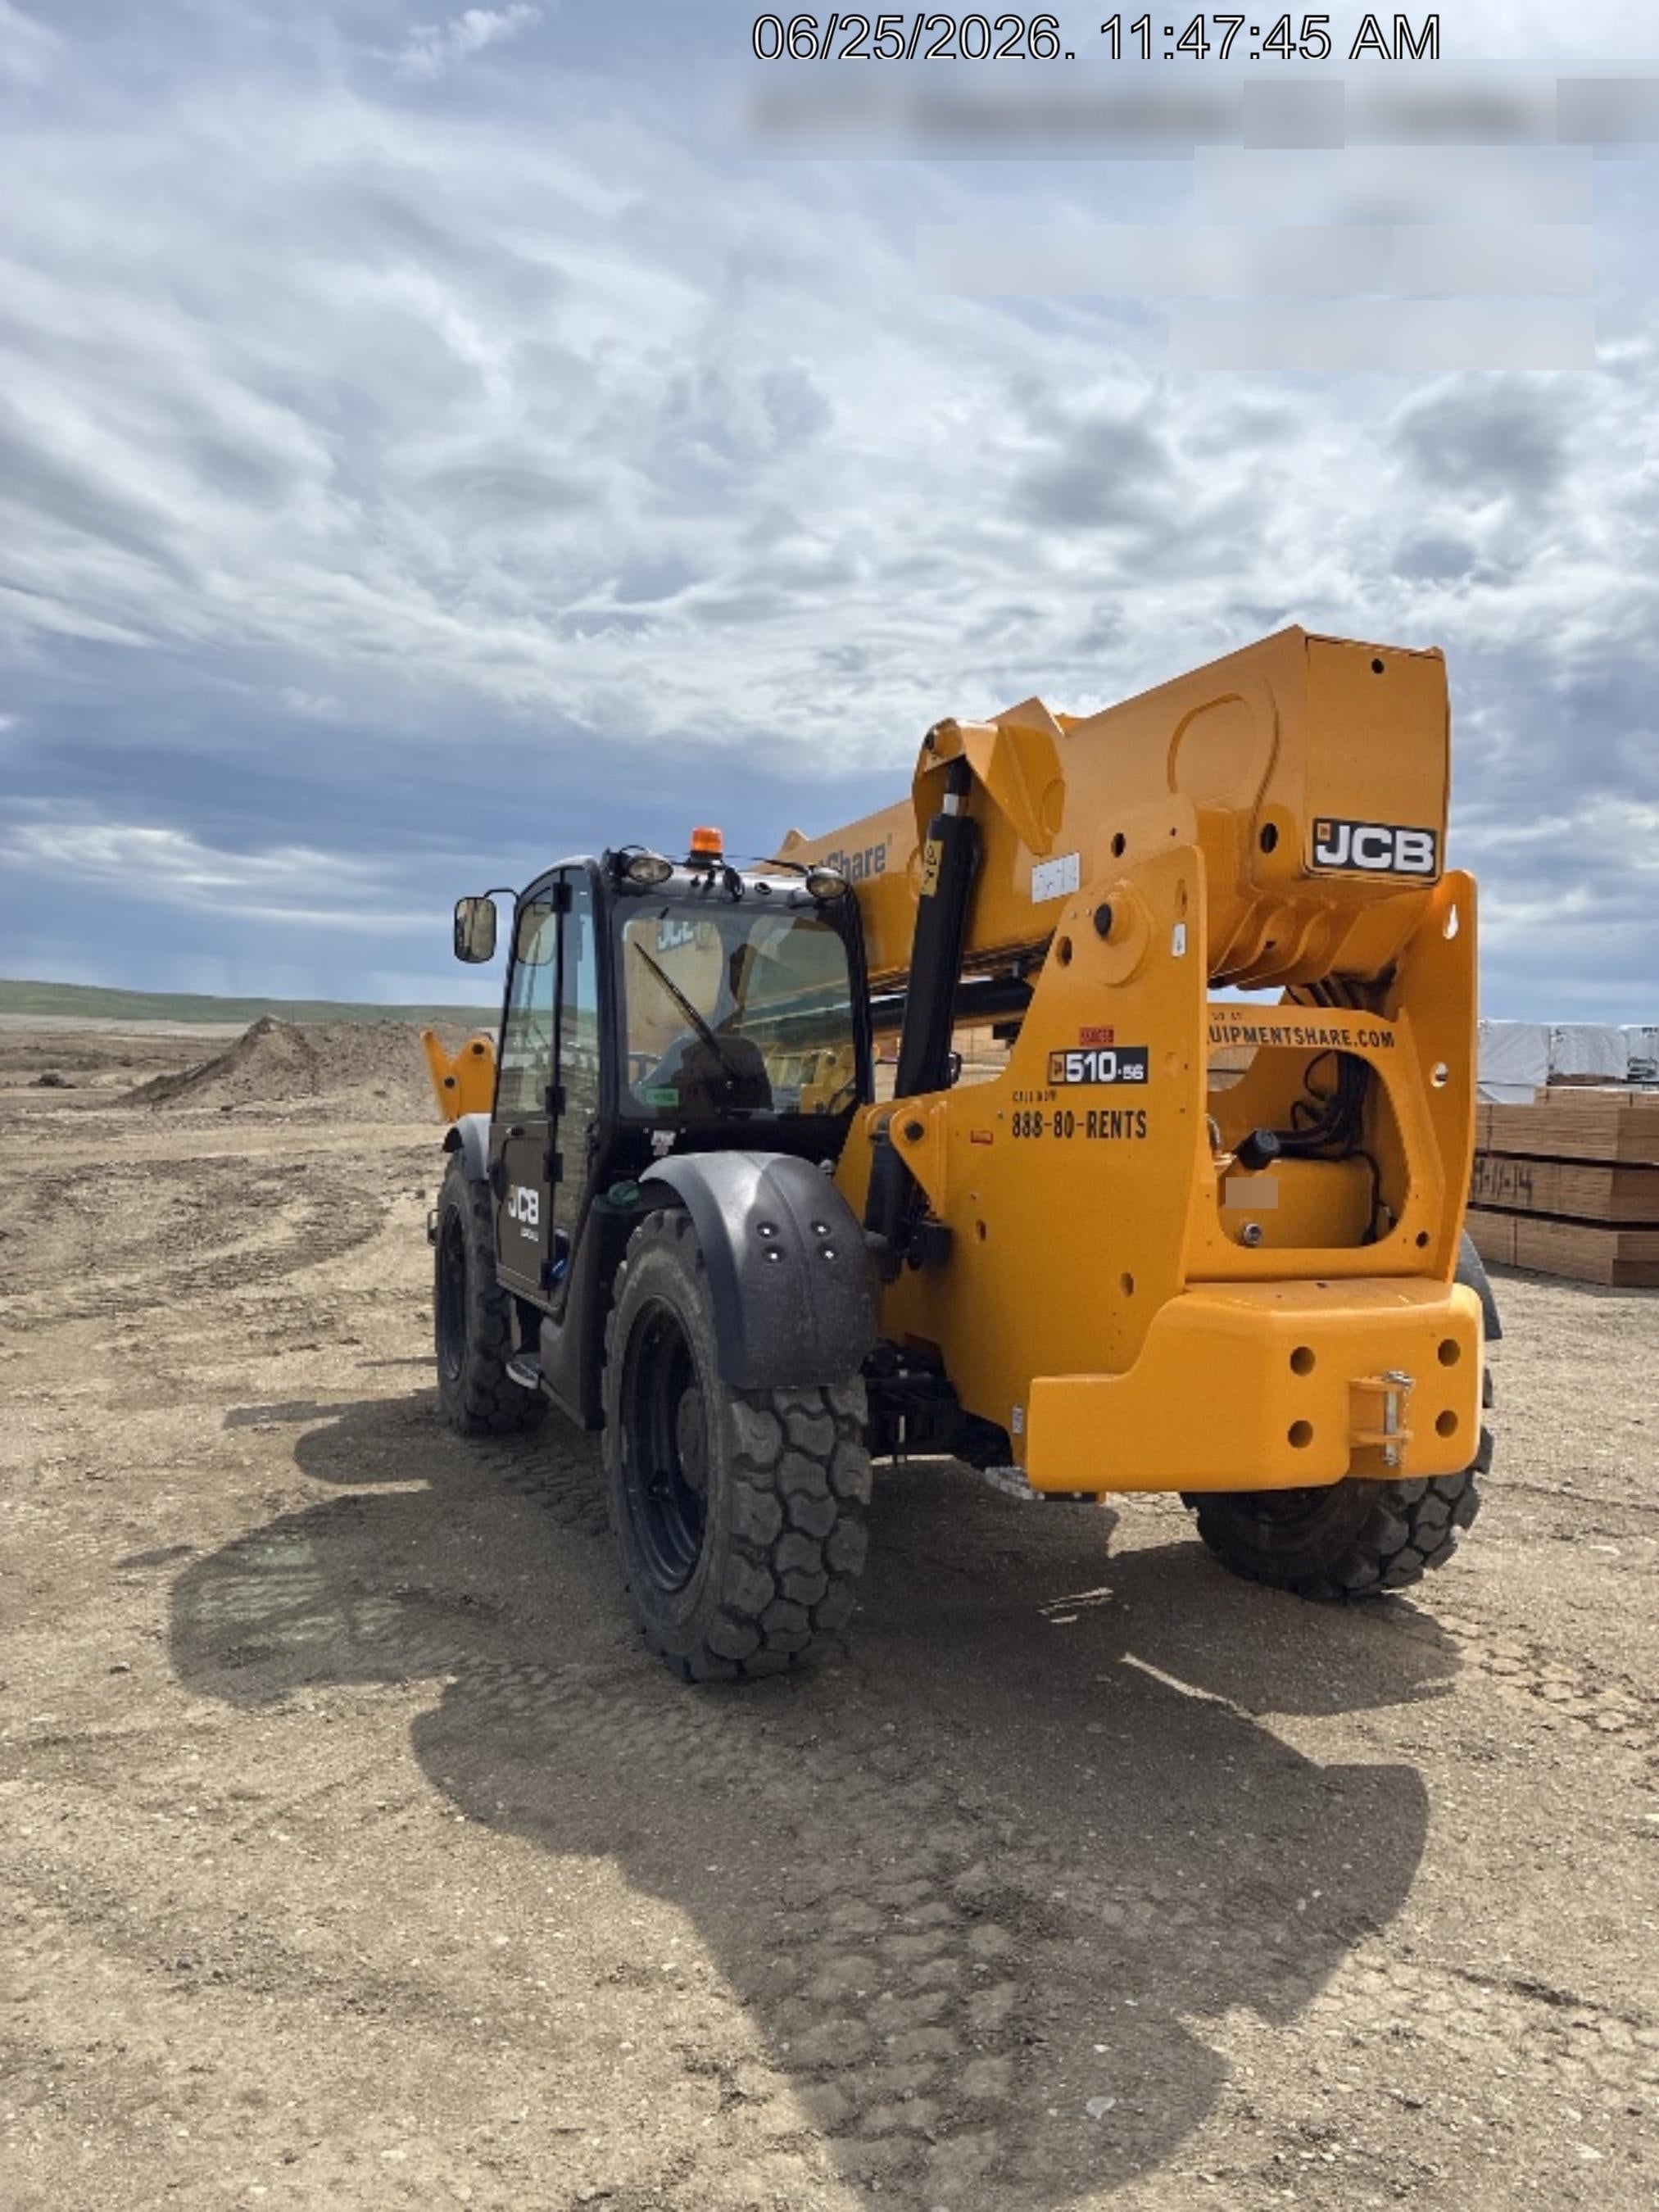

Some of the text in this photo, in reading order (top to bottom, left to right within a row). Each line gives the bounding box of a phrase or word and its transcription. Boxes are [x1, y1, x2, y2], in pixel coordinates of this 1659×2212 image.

[1316, 824, 1435, 873] JCB
[1208, 1025, 1395, 1049] UIPMENTSHARE.COM
[1011, 1110, 1147, 1140] 888-80-RENTS
[507, 1184, 539, 1225] JCB
